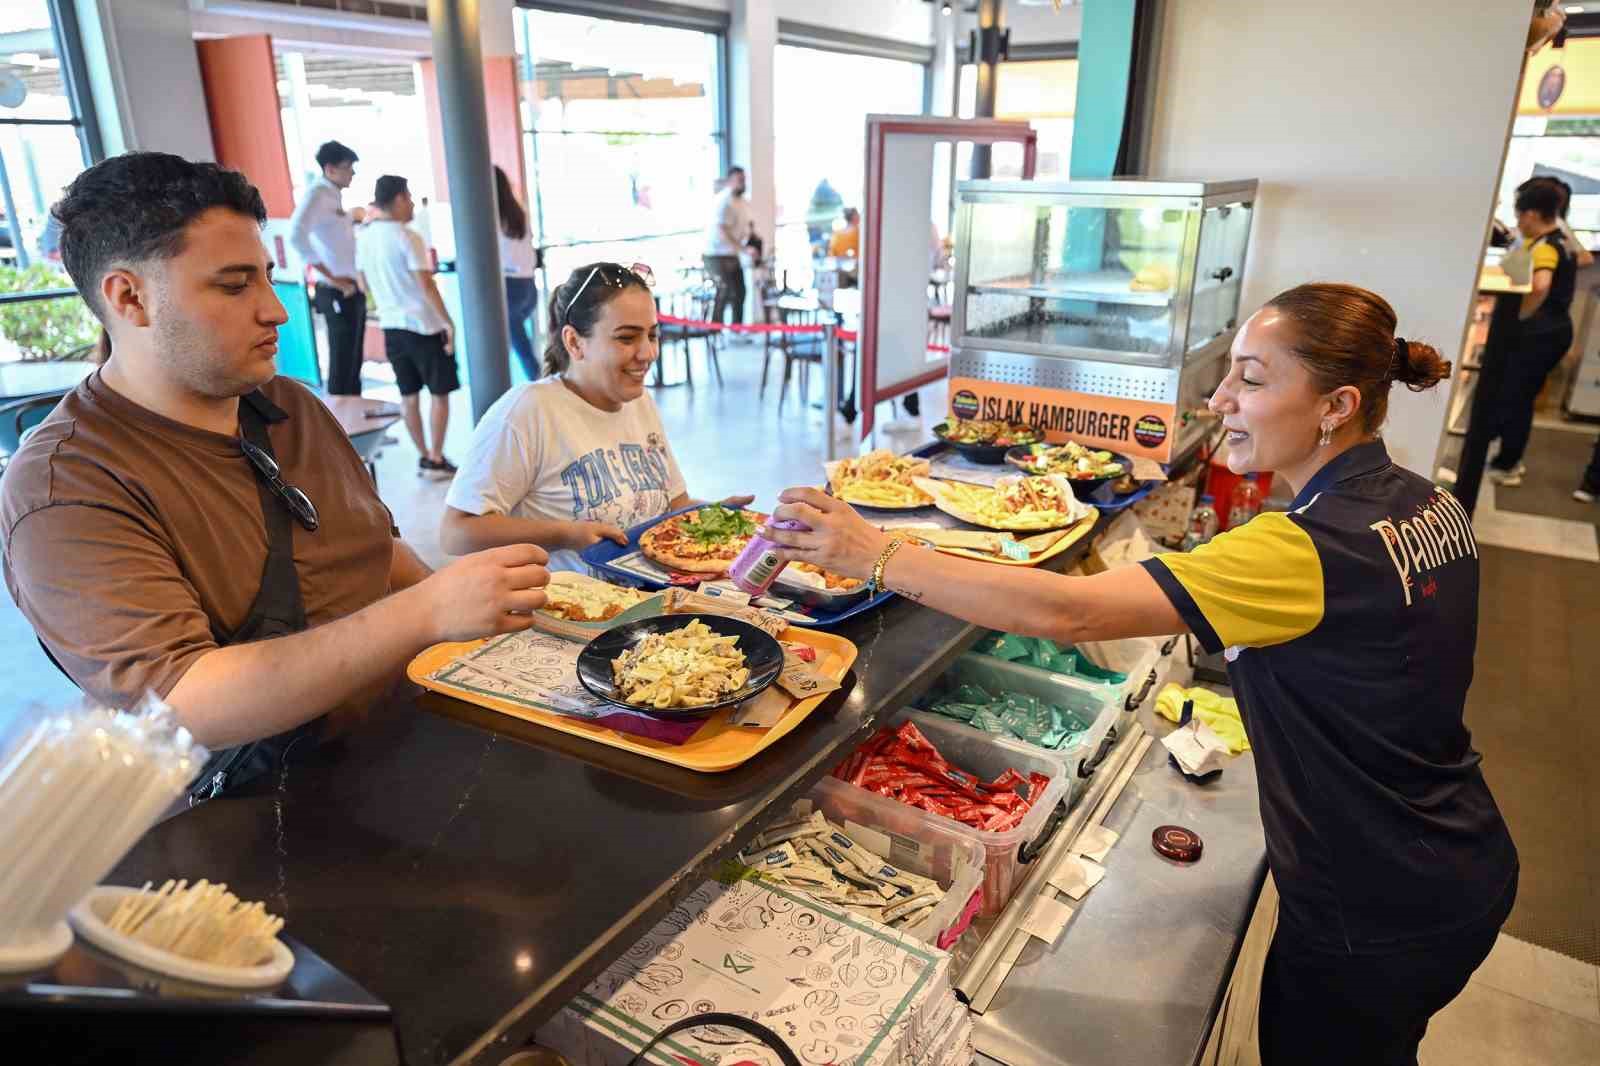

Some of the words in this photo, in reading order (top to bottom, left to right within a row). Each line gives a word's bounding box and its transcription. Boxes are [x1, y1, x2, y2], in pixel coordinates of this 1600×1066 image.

[982, 396, 1025, 426] ISLAK
[1029, 401, 1131, 441] HAMBURGER
[561, 448, 621, 513] TOM
